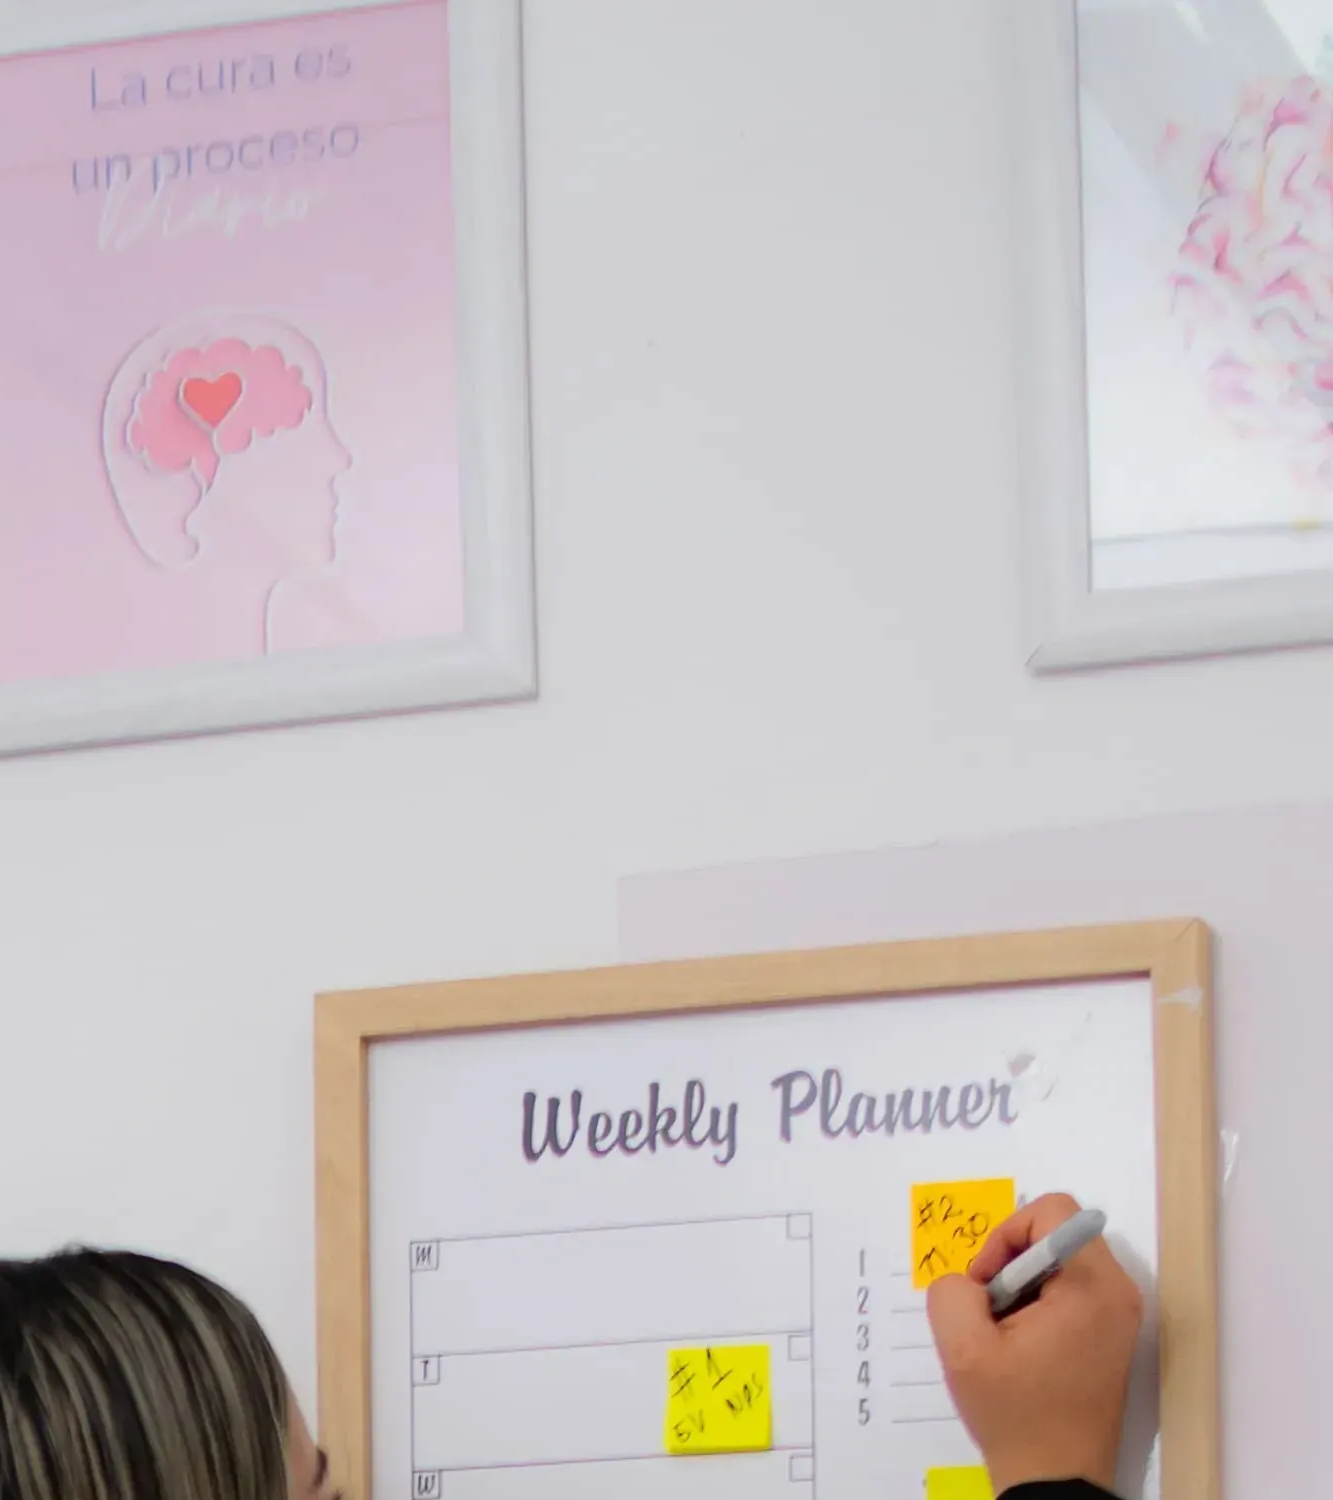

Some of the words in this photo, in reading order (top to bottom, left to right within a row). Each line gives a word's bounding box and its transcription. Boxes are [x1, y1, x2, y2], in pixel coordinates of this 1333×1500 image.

[90, 66, 147, 112] La
[165, 53, 276, 99] cura
[294, 44, 352, 81] es
[71, 152, 132, 195] un
[152, 123, 360, 196] proceso
[521, 1079, 739, 1167] Weekly
[771, 1068, 1019, 1144] Planner
[416, 1244, 432, 1267] M
[856, 1286, 870, 1315] 2
[856, 1323, 870, 1352] 3
[856, 1359, 871, 1389] 4
[857, 1397, 871, 1426] 5
[417, 1474, 435, 1496] W
